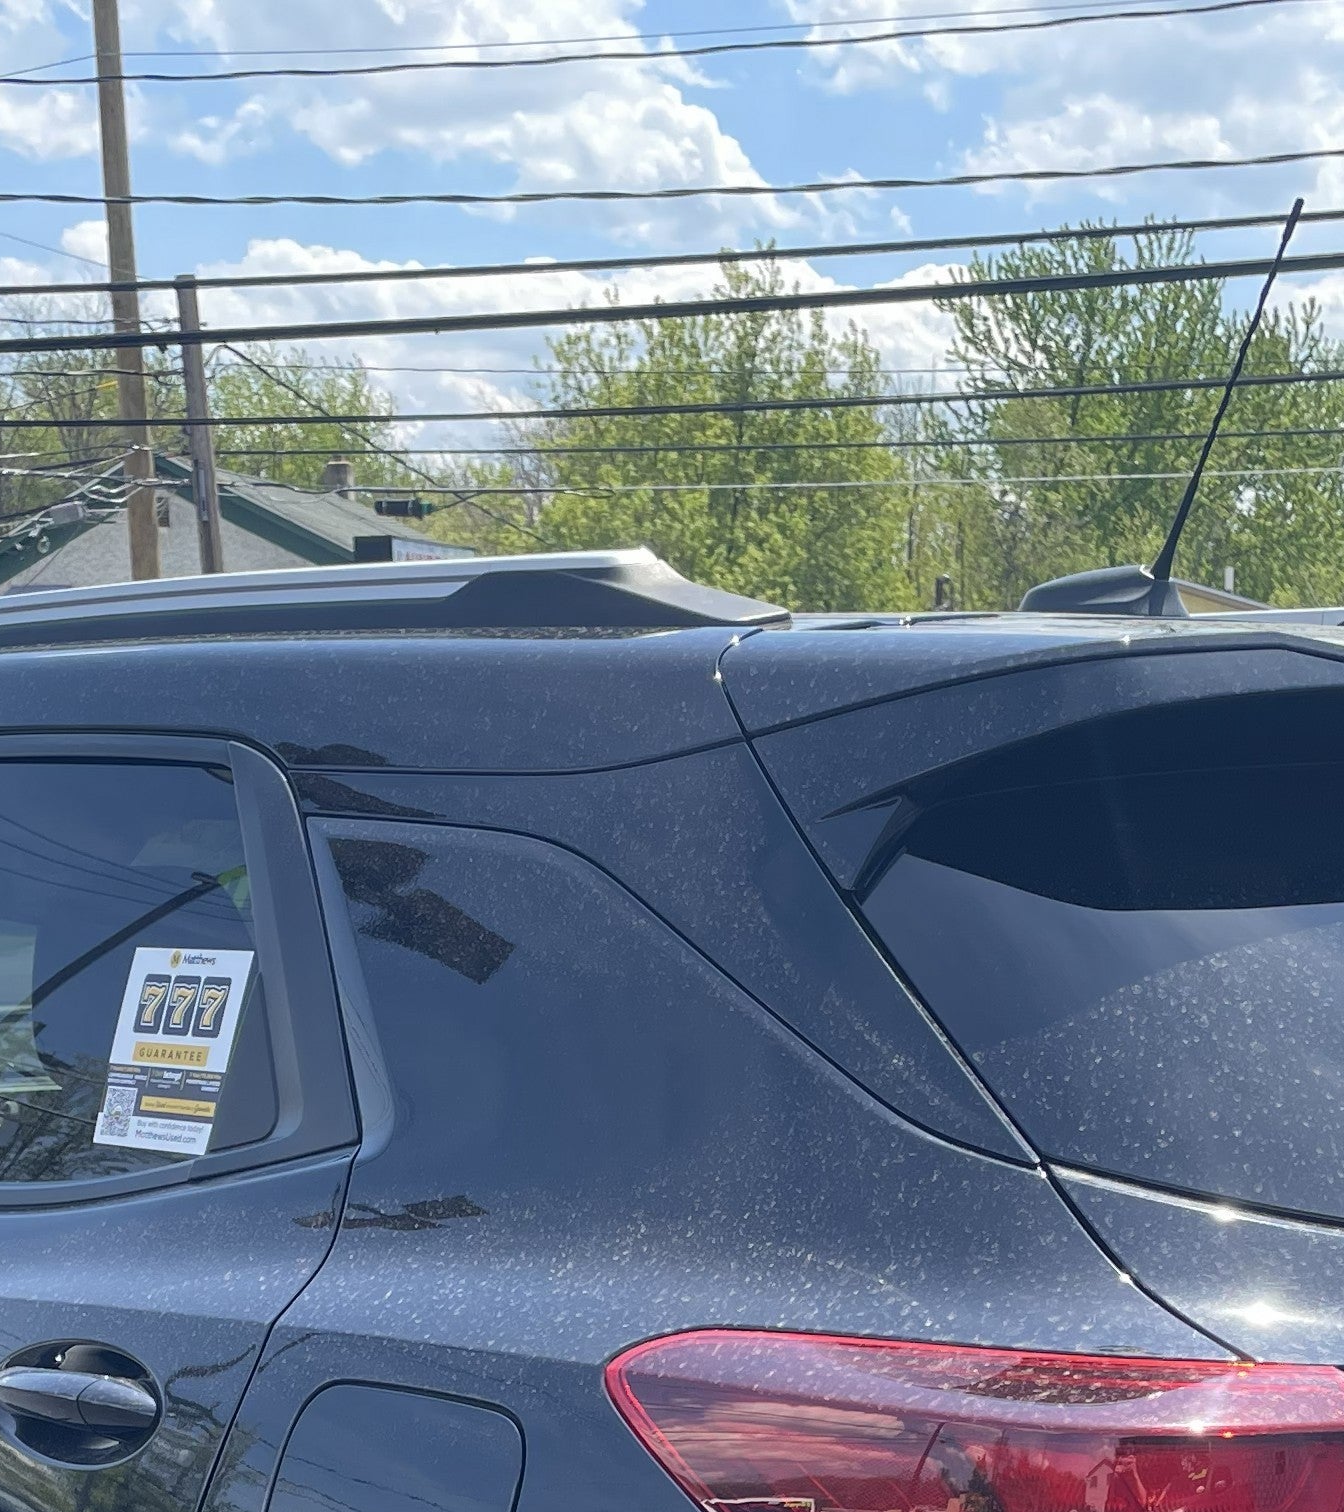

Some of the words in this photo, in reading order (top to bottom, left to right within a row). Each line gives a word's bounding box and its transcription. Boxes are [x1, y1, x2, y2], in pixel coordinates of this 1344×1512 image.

[182, 952, 217, 966] Matthews
[138, 1046, 203, 1062] GUARANTEE
[159, 1122, 186, 1131] confidence
[135, 1129, 197, 1143] MatthewsUsed.com
